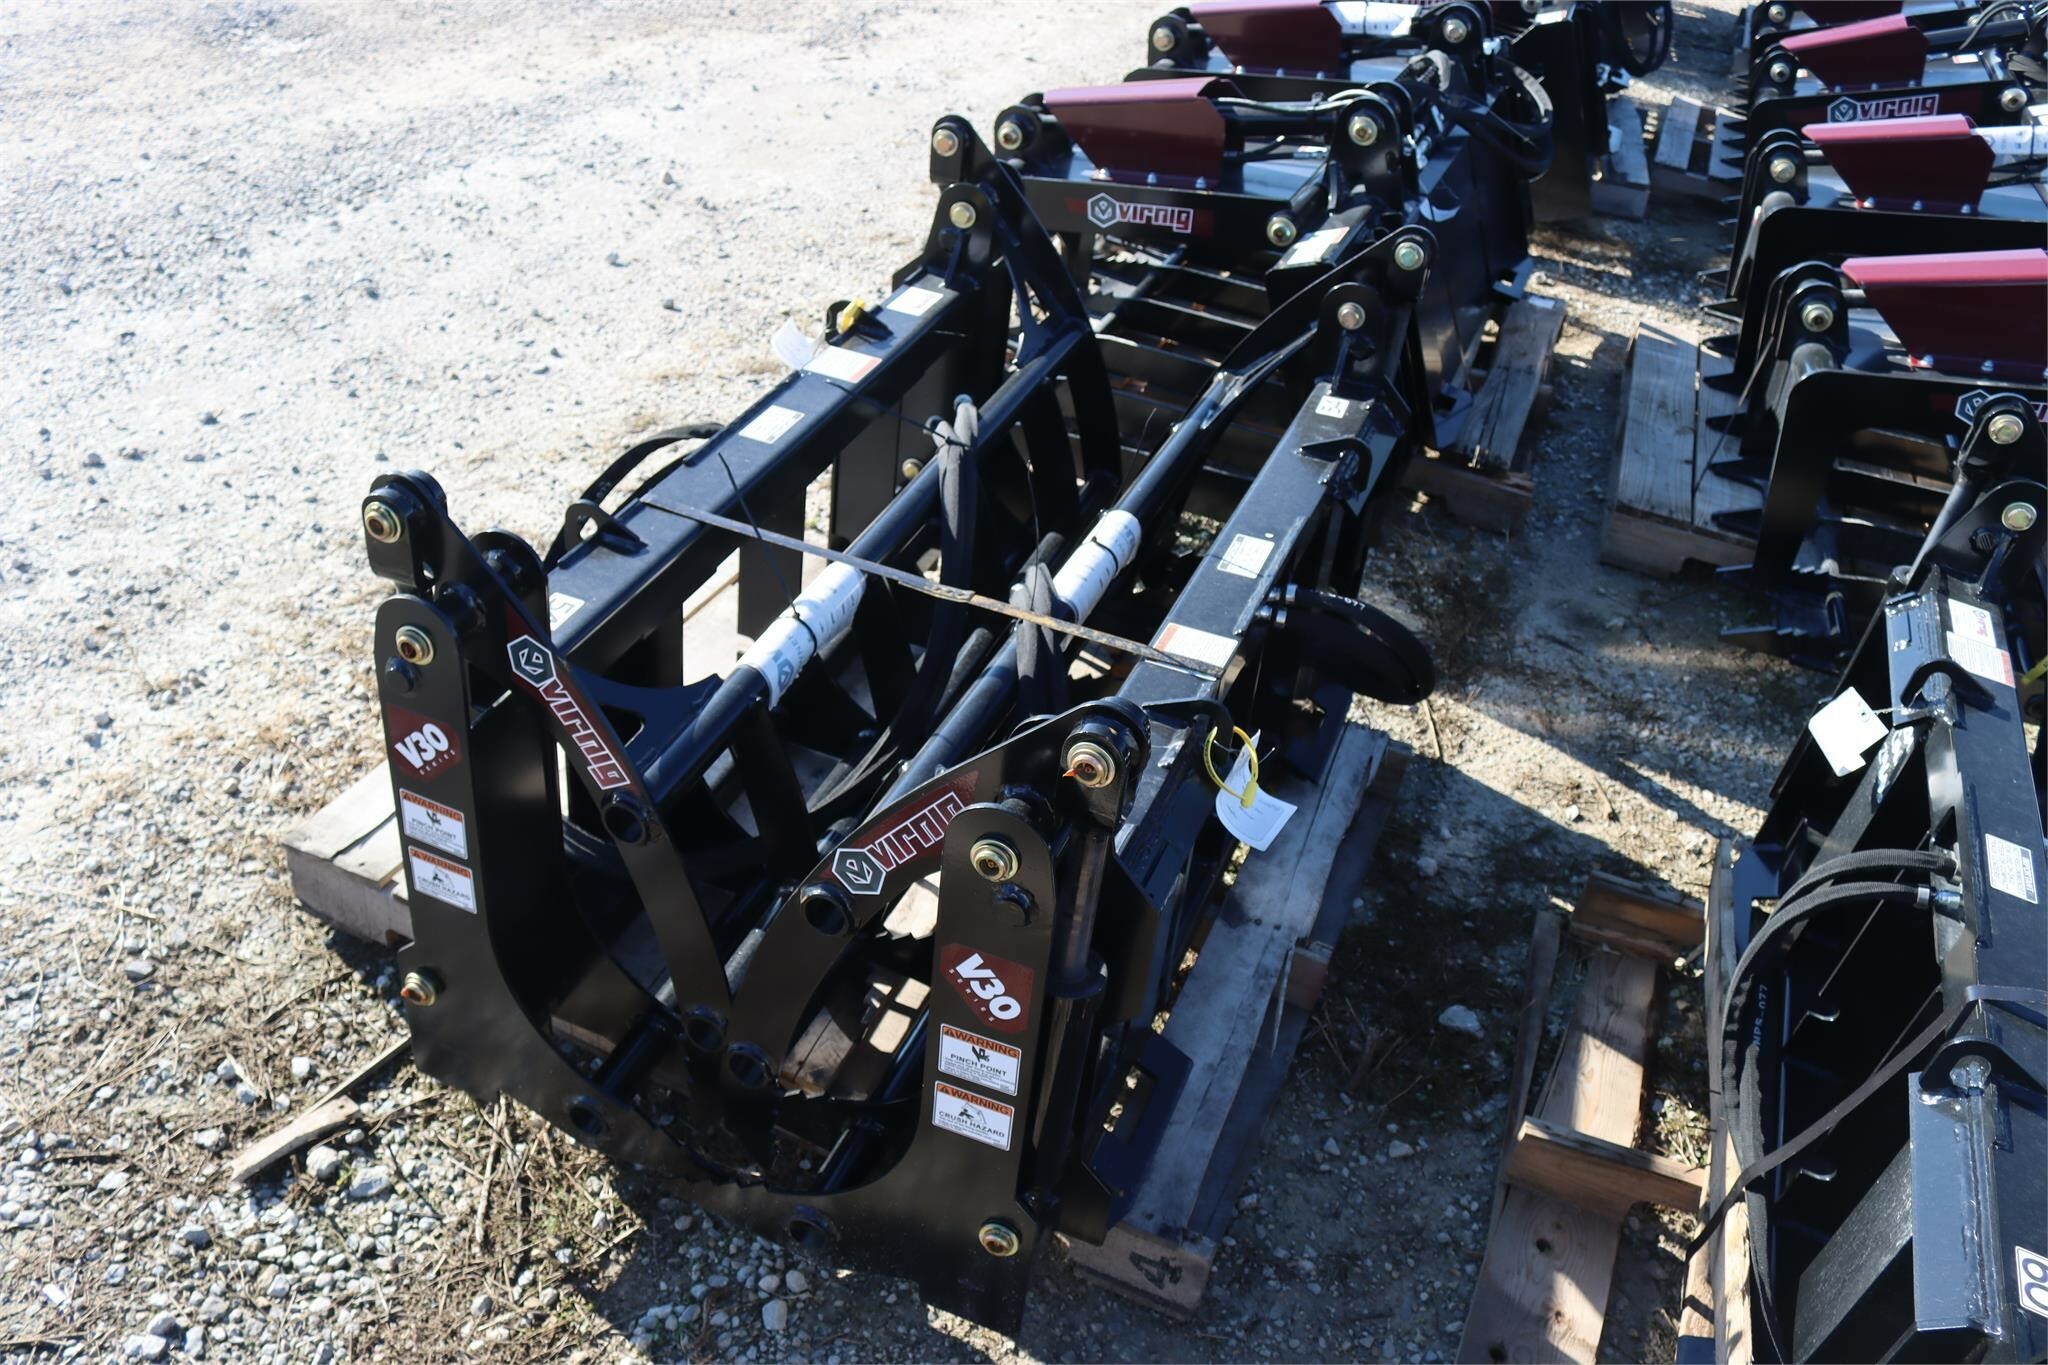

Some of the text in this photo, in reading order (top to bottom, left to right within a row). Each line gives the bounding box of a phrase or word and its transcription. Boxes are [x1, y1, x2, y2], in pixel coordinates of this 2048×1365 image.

[394, 723, 449, 769] V30
[408, 792, 461, 821] WARNING
[418, 850, 469, 877] WARNING
[955, 952, 1021, 1020] V30
[955, 1029, 1018, 1058] WARNING
[949, 1052, 1007, 1077] PINCH POINT
[950, 1087, 1009, 1115] WARNING
[938, 1109, 967, 1125] CRUSH
[969, 1120, 1005, 1138] HAZARD
